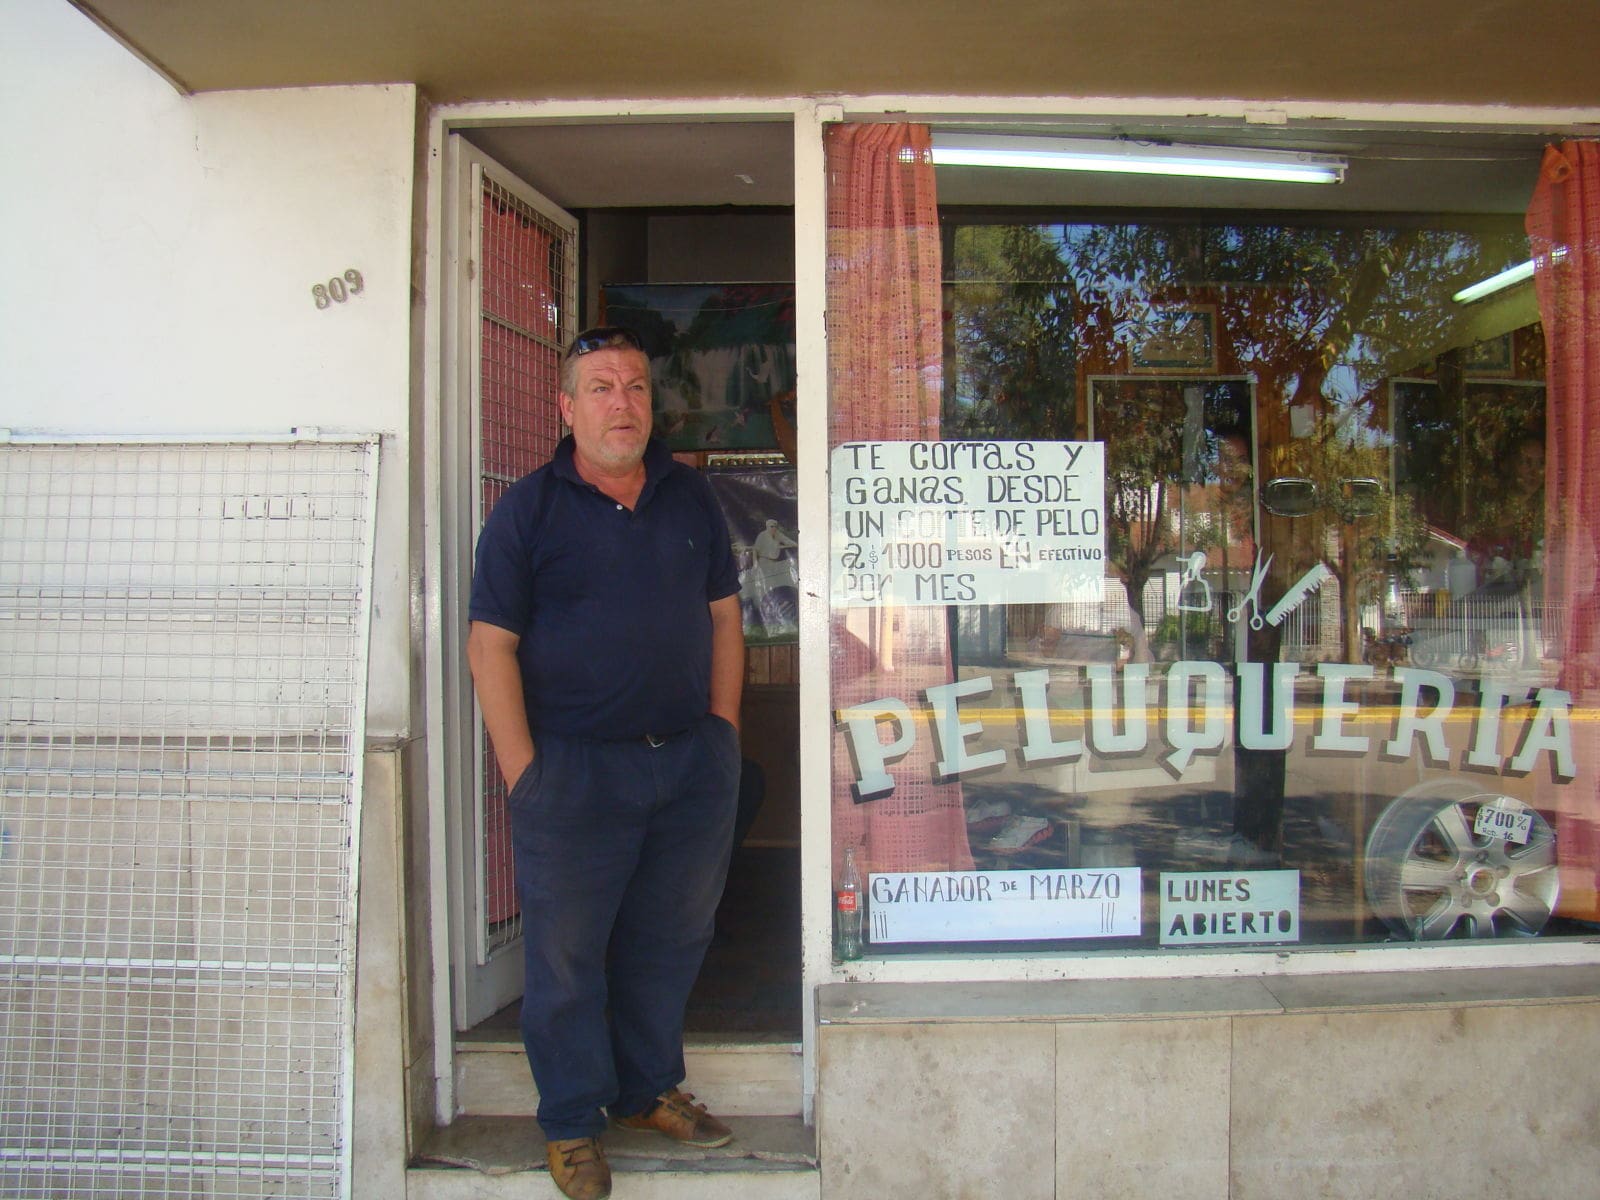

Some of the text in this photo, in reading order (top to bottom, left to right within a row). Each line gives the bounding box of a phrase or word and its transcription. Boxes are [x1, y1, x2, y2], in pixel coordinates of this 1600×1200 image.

[311, 268, 364, 310] 809
[843, 444, 885, 470] TE
[1063, 444, 1084, 471] Y
[987, 474, 1081, 504] DESDE
[844, 510, 884, 538] UN
[995, 509, 1026, 537] DE
[1036, 508, 1099, 537] PELO
[946, 548, 993, 562] PESOS
[999, 541, 1032, 569] EN
[915, 573, 977, 601] MES
[836, 660, 1577, 803] PELUQUERIA
[871, 873, 1120, 903] GANADOR DE MARZO
[1167, 878, 1251, 902] LUNES
[1168, 909, 1292, 936] ABIERTO
